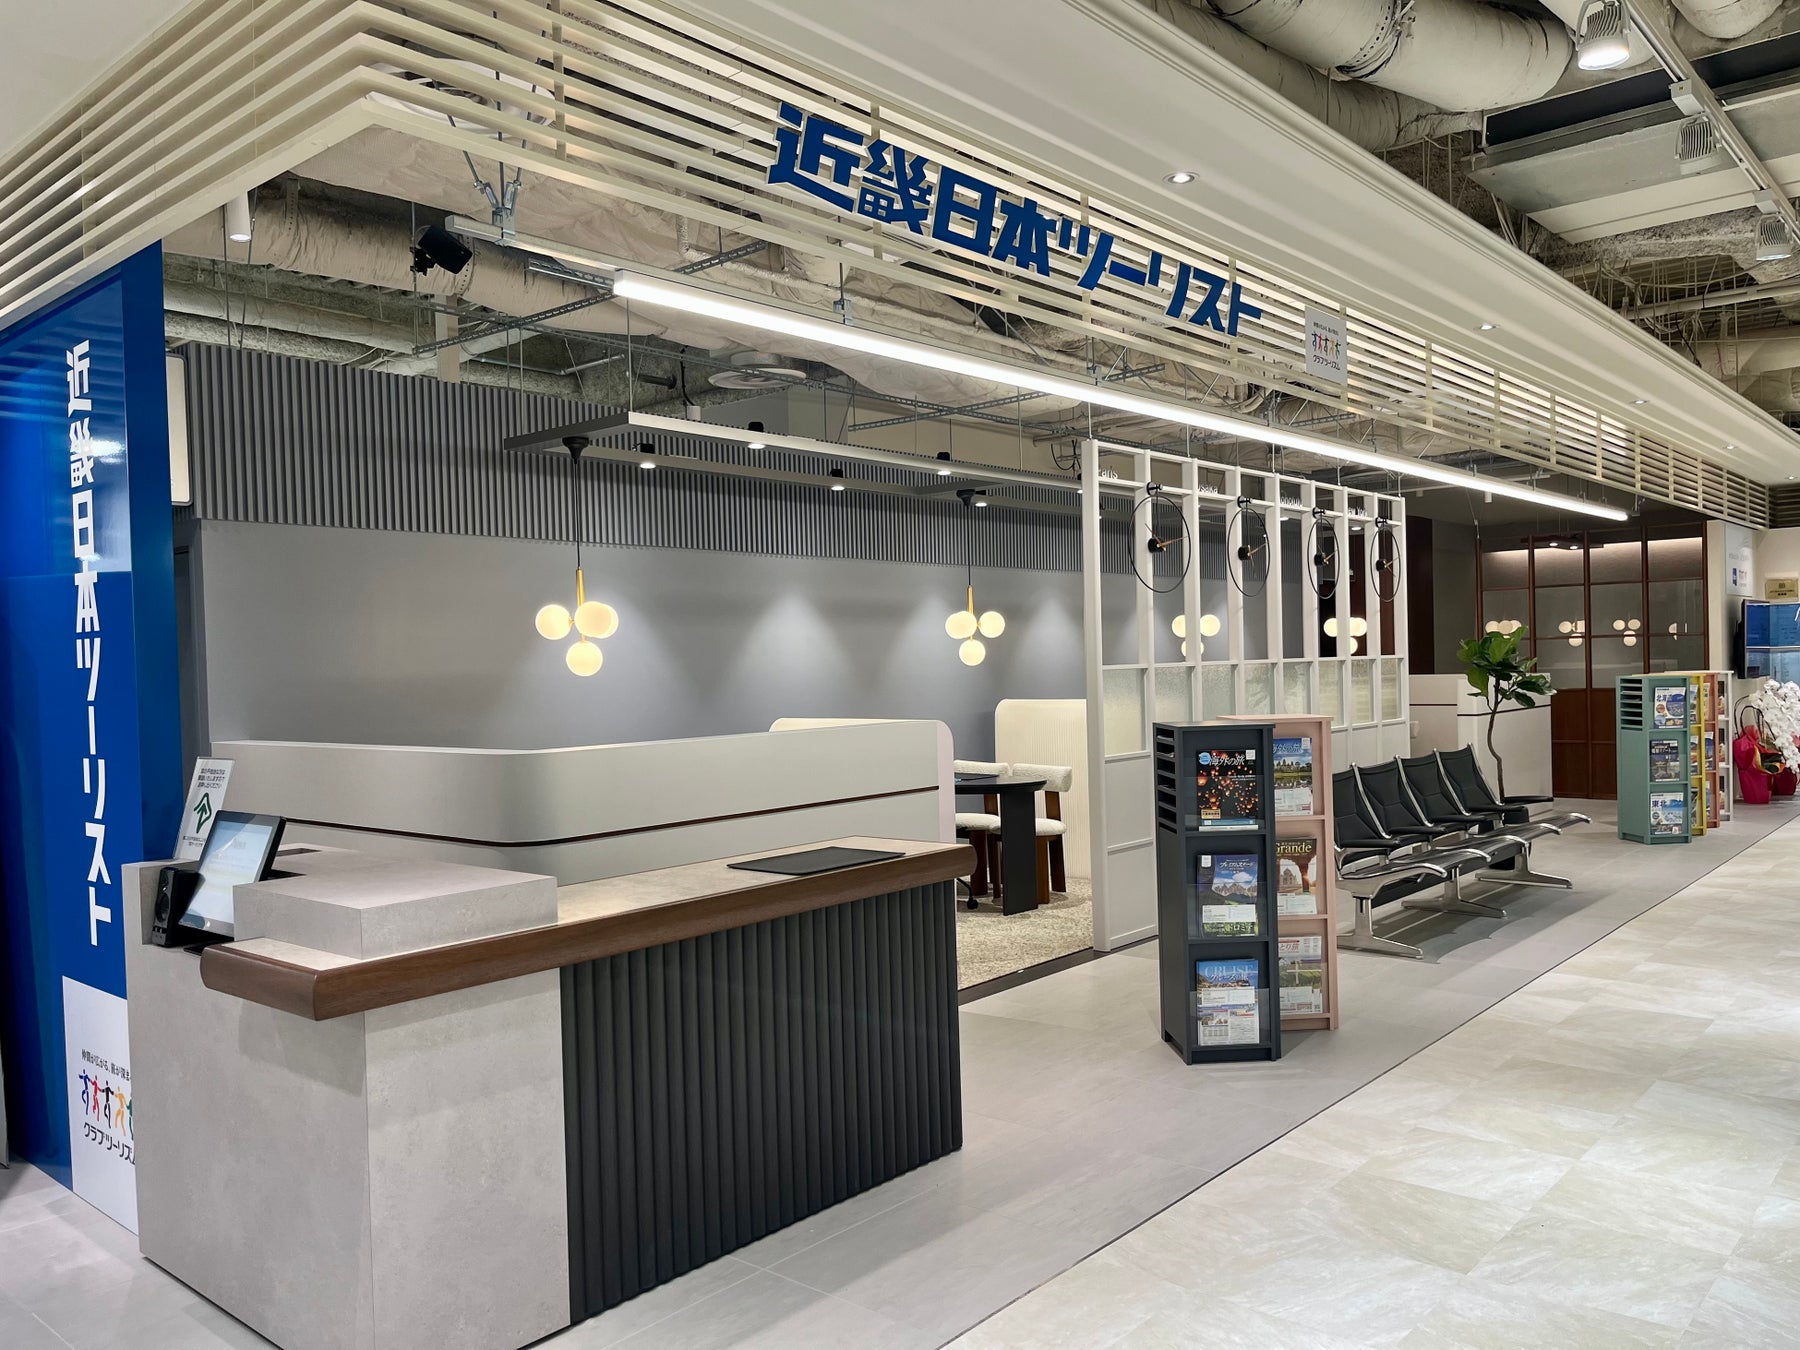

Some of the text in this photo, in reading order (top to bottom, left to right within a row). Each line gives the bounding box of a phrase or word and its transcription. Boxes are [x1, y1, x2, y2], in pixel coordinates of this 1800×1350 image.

[767, 102, 1262, 336] 近畿日本ツーリスト
[66, 340, 112, 947] 近畿日本ツーリスト
[1210, 754, 1246, 767] 海外の旅
[1651, 799, 1668, 808] 東北
[1204, 964, 1254, 979] CRUISE
[81, 1048, 131, 1082] 仲間が広がる、旅が深ま
